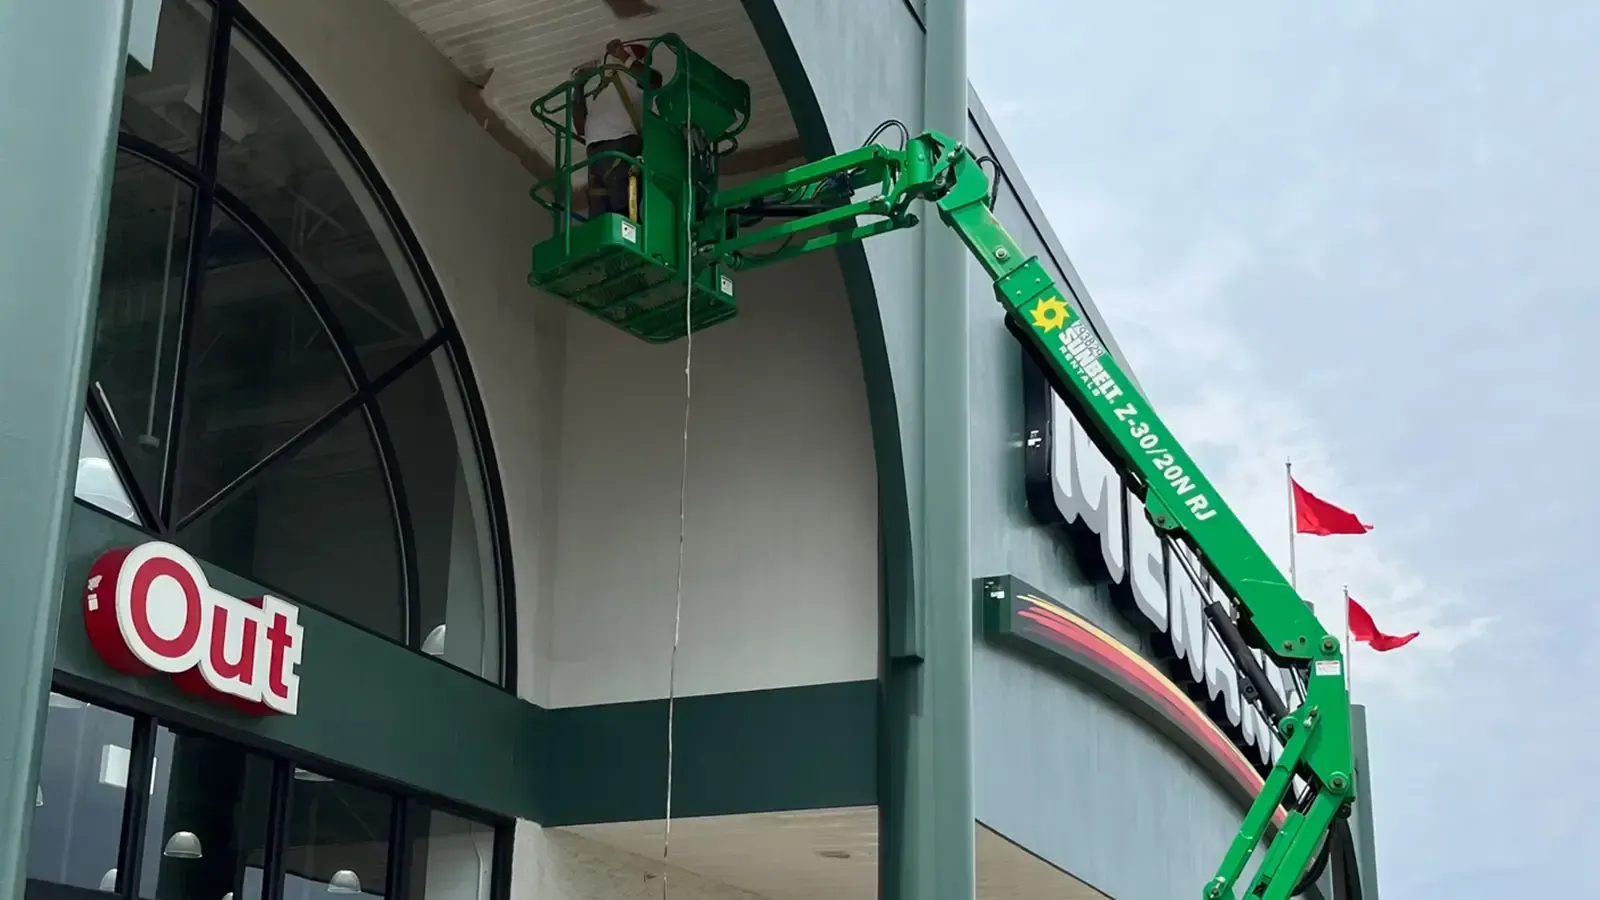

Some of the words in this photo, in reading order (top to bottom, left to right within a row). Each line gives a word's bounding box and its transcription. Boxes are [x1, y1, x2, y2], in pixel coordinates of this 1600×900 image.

[1058, 346, 1100, 397] RENTALS
[1113, 403, 1196, 496] Z-30/20N
[1185, 496, 1217, 521] RJ
[130, 557, 293, 699] Out
